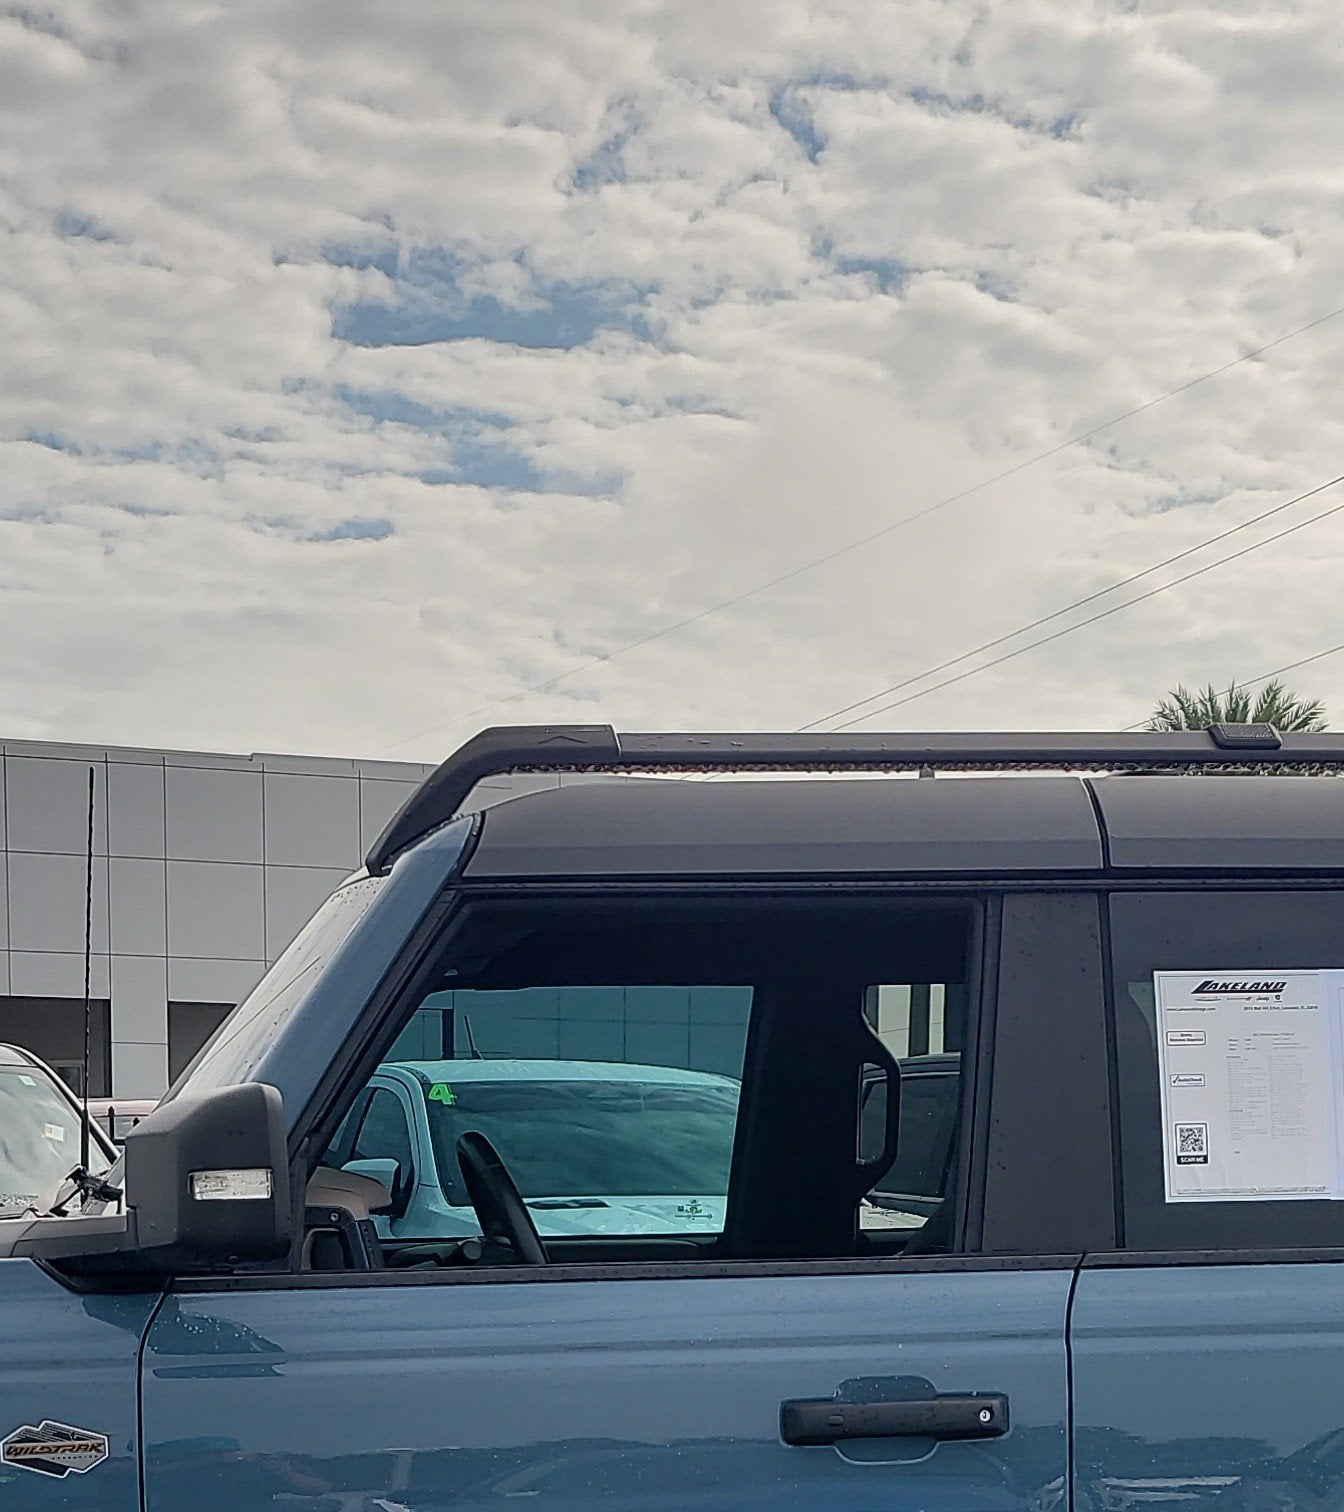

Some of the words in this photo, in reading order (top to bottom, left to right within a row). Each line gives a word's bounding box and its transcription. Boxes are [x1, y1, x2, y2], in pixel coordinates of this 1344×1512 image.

[1191, 980, 1287, 994] LAKELAND
[428, 1083, 452, 1106] 4
[6, 1443, 104, 1456] WILDTRAK
